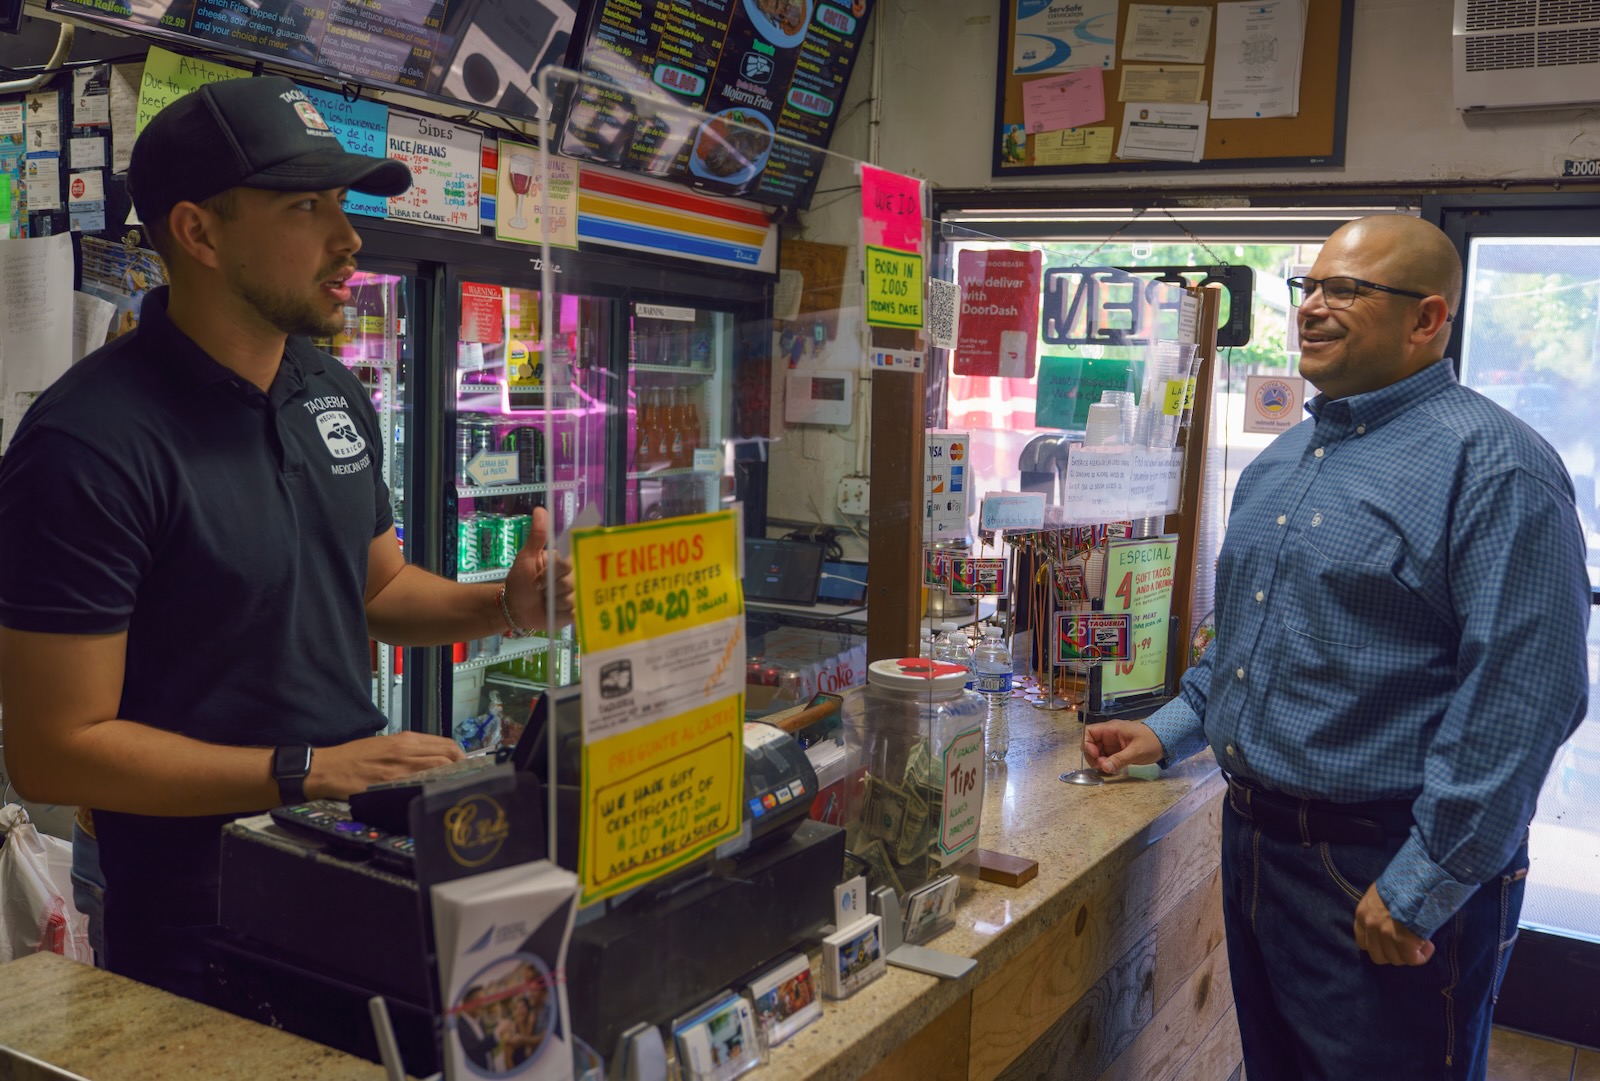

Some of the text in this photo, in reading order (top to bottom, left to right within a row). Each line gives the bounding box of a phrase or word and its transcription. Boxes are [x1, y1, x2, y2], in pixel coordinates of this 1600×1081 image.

[229, 0, 297, 27] Fries topped with,
[331, 0, 428, 35] Cheese, lettuce and parmesan
[1048, 4, 1082, 14] ServSafe
[160, 15, 186, 28] $12.99
[197, 7, 317, 44] cheese, sour cream, guacamole
[328, 12, 353, 26] cheese
[354, 18, 368, 29] and
[367, 23, 383, 34] your
[384, 28, 405, 40] choice
[195, 20, 289, 51] and your choice of meat.
[326, 22, 371, 43] Taco Salad
[363, 46, 377, 55] sour
[341, 62, 355, 72] and
[144, 72, 163, 91] Due
[166, 76, 180, 95] to
[662, 68, 698, 93] CALDOS
[142, 91, 168, 110] beef
[306, 90, 353, 114] tencion
[721, 84, 755, 105] Mojarra
[753, 94, 774, 111] Frita
[330, 112, 343, 124] los
[346, 128, 375, 142] de la
[346, 140, 374, 153] toda
[389, 138, 447, 159] RICE/BEANS
[389, 152, 409, 163] LARGE
[874, 186, 893, 214] WE
[423, 210, 446, 222] CARNE
[874, 257, 915, 279] BORN IN
[987, 260, 1024, 268] DOORDASH
[963, 276, 1025, 289] We deliver
[962, 289, 987, 301] with
[870, 300, 919, 316] TODAYS DATE
[961, 303, 1018, 317] DoorDash
[303, 395, 349, 415] TAQUERIA
[318, 412, 348, 425] HECHO EN
[334, 441, 363, 456] MEXICO
[928, 445, 942, 458] VISA
[331, 459, 362, 475] MEXICAN
[479, 458, 509, 468] CERRAR BIEN
[483, 467, 508, 476] LA PUERTA
[462, 522, 478, 573] Sprite
[499, 518, 516, 568] Sprite
[595, 533, 705, 582] TENEMOS
[1119, 546, 1171, 566] ESPECIAL
[959, 563, 973, 575] 26
[594, 563, 722, 606] GIFT CERTIFICATES
[1115, 571, 1133, 610] 4
[1135, 571, 1151, 585] SOFT
[1152, 566, 1172, 580] TACOS
[1135, 583, 1150, 595] AND
[1150, 582, 1155, 592] A
[1142, 611, 1157, 621] MEAT
[1066, 621, 1087, 637] 25
[817, 666, 853, 693] Coke
[607, 727, 678, 773] PREGUNTE
[682, 725, 696, 741] AL
[601, 766, 697, 818] WE HAVE GIFT
[606, 775, 714, 834] CERTIFICATES OF
[608, 855, 637, 879] ASK
[679, 817, 720, 847] CASHIER
